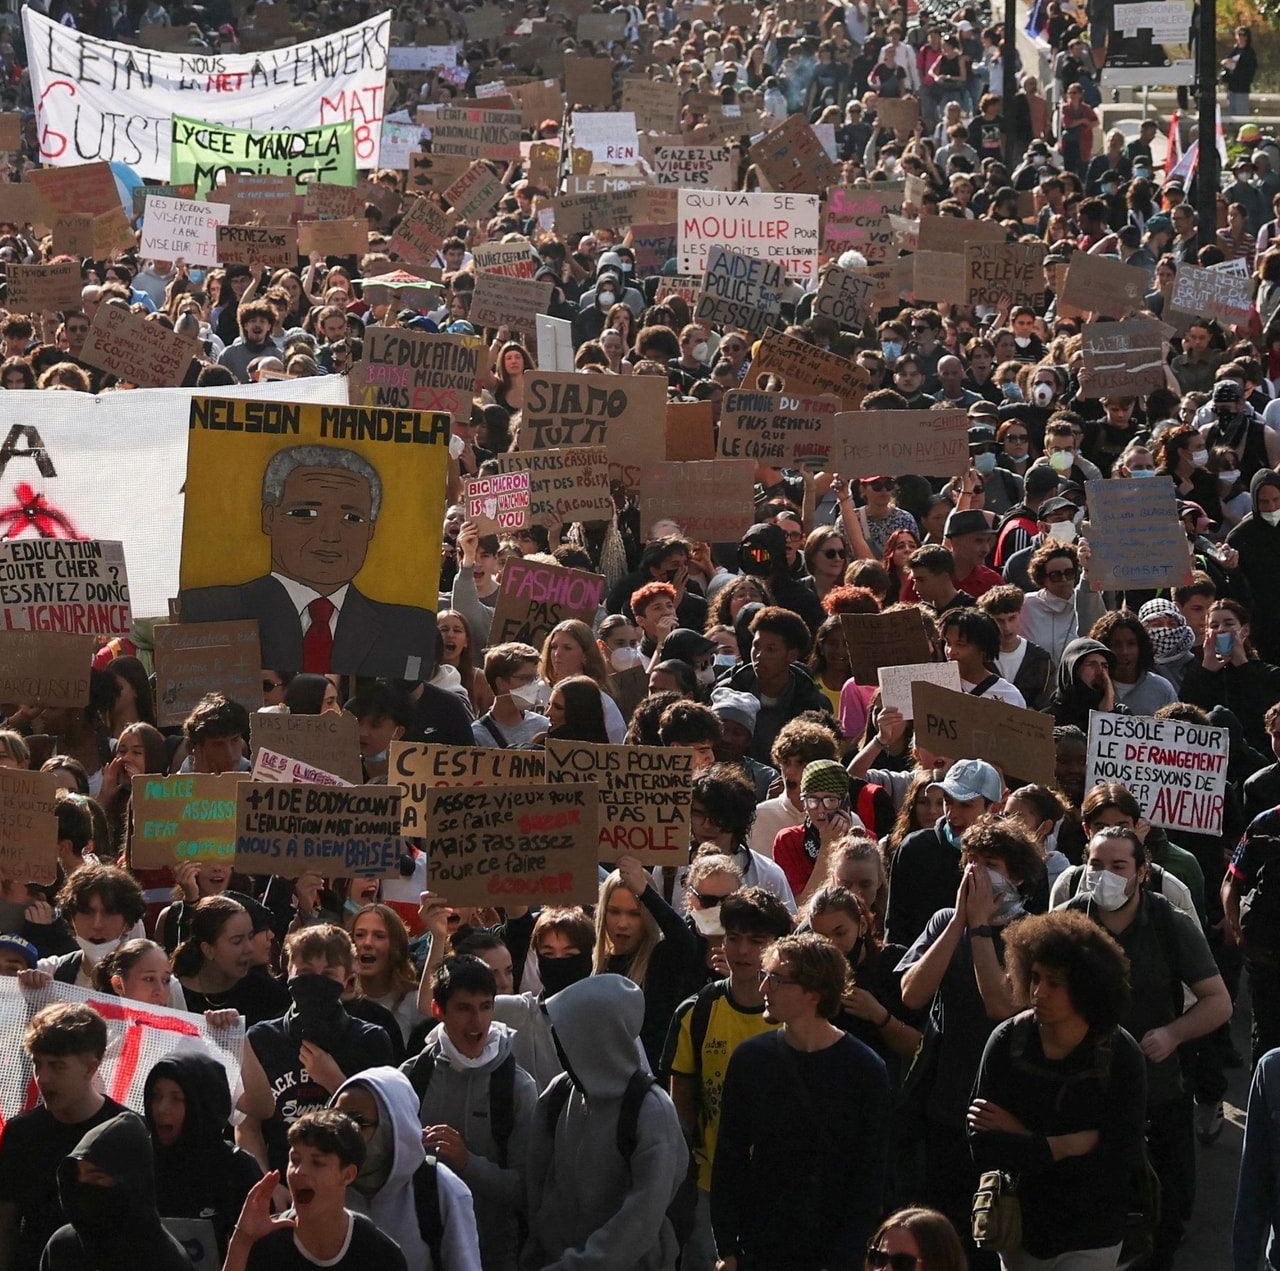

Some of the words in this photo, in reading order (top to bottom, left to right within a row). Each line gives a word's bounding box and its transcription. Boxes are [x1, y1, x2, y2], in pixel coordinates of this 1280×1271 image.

[180, 57, 227, 73] NOUS
[206, 72, 249, 93] MET
[320, 86, 384, 126] MAI
[245, 129, 340, 160] MANDELA
[434, 126, 480, 139] NATIONALE
[481, 127, 509, 144] NOUS
[657, 161, 713, 171] VIOLEURS
[446, 161, 489, 203] ABSENTS
[575, 177, 596, 193] LE
[658, 171, 679, 183] PAS
[684, 171, 709, 183] LES
[150, 199, 167, 209] LES
[773, 196, 796, 210] SE
[153, 211, 194, 226] VISENT
[194, 217, 205, 227] LE
[185, 229, 200, 238] BAC
[220, 228, 267, 242] PRENEZ
[270, 234, 287, 246] VOS
[794, 228, 817, 239] POUR
[145, 238, 169, 250] VISE
[172, 240, 191, 252] LEUR
[683, 243, 706, 254] LES
[768, 245, 784, 256] DE
[7, 267, 19, 278] LE
[713, 252, 762, 283] AIDE
[763, 261, 780, 287] LA
[705, 271, 756, 306] POLICE
[826, 267, 873, 297] C'EST
[1178, 278, 1194, 289] ON
[1228, 289, 1249, 300] DU
[1215, 275, 1245, 290] NOUS
[839, 291, 856, 305] PAS
[1172, 297, 1193, 309] QUE
[1177, 287, 1210, 302] BRUIT
[109, 310, 125, 323] ON
[699, 297, 781, 335] DESSUS
[819, 295, 865, 328] COOL
[130, 330, 184, 359] TRAVAILLER
[366, 365, 410, 387] BAISE
[414, 369, 458, 389] MIEUX
[459, 378, 475, 392] QUE
[377, 387, 409, 408] NOS
[413, 387, 459, 412] EXS
[528, 379, 628, 418] SIAMO
[779, 396, 799, 410] DU
[191, 397, 300, 435] NELSON
[320, 407, 451, 446] MANDELA
[528, 418, 608, 449] TUTTI
[761, 430, 785, 440] QUE
[722, 437, 740, 457] LE
[879, 442, 910, 458] MON
[914, 439, 965, 458] AVENIR
[525, 456, 563, 472] VRAIS
[469, 481, 490, 496] BIG
[492, 473, 529, 493] MACRON
[554, 477, 574, 490] DES
[577, 472, 608, 488] ROLEX
[471, 499, 482, 515] IS
[498, 491, 529, 510] WATCHING
[532, 501, 554, 515] DES
[556, 498, 612, 515] CAGOULES
[499, 512, 524, 528] YOU
[56, 559, 99, 578] CHER
[1112, 565, 1174, 577] COMBAT
[0, 583, 78, 604] ESSAYEZ
[85, 583, 130, 603] DONC
[4, 605, 131, 634] L'IGNORANCE
[527, 600, 562, 623] PAS
[926, 713, 958, 740] PAS
[1099, 716, 1163, 742] DÉSOLÉ
[1175, 726, 1222, 749] POUR
[261, 752, 287, 771] LES
[396, 746, 486, 777] C'EST
[492, 754, 545, 779] L'ANN
[548, 747, 620, 772] VOUS
[628, 751, 693, 773] POUVEZ
[1098, 741, 1119, 759] LE
[1125, 741, 1226, 773] DÉRANGEMENT
[1094, 761, 1132, 780] NOUS
[1134, 764, 1192, 786] ESSAYONS
[1194, 774, 1216, 791] DE
[146, 779, 194, 799] POLICE
[599, 790, 691, 807] TELEPHONES
[280, 788, 303, 809] DE
[305, 788, 402, 816] BODYCOUNT
[1150, 786, 1224, 829] AVENIR
[246, 813, 322, 833] L'EDUCATION
[607, 806, 646, 823] PAS
[657, 806, 685, 823] LA
[144, 821, 178, 838] ETAT
[599, 826, 678, 850] AROLE
[236, 836, 280, 856] NOUS
[521, 835, 575, 851] assez
[477, 856, 500, 874] ce
[506, 852, 546, 873] faire
